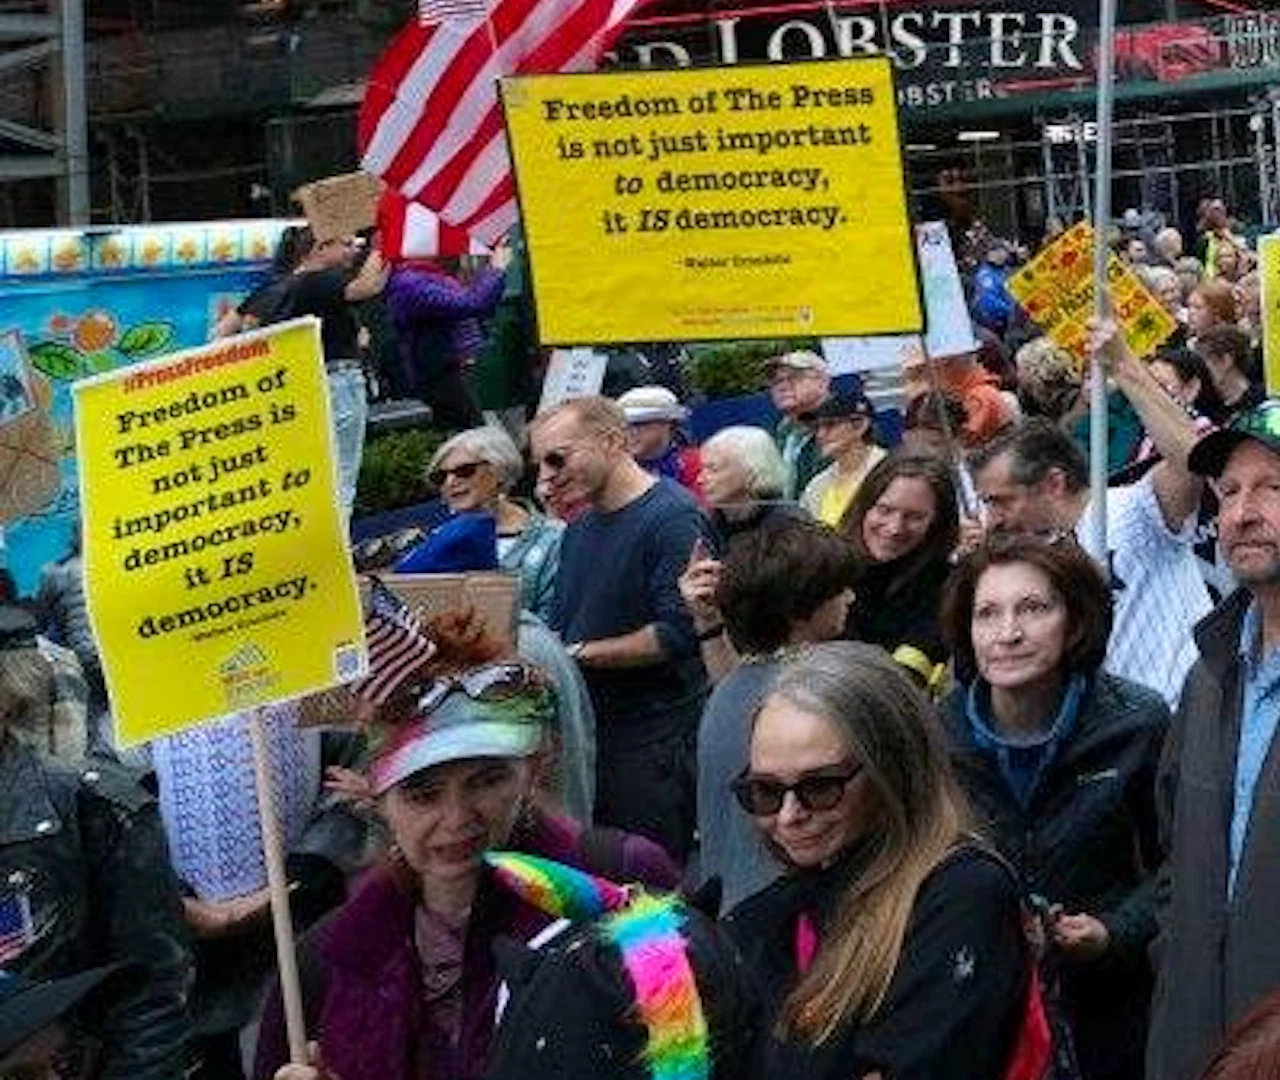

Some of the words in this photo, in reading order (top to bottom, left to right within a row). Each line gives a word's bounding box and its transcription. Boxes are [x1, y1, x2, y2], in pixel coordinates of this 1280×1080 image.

[542, 91, 680, 123] Freedom
[688, 89, 717, 114] of
[724, 86, 782, 111] The
[790, 82, 875, 109] Press
[557, 135, 585, 160] is
[593, 135, 643, 159] not
[647, 128, 709, 162] just
[716, 122, 873, 161] important
[614, 173, 643, 195] to
[656, 165, 831, 195] democracy,
[602, 209, 628, 234] it
[636, 207, 669, 232] IS
[674, 203, 848, 232] democracy.
[116, 384, 250, 434] Freedom
[256, 368, 288, 394] of
[114, 440, 171, 469] The
[179, 413, 263, 451] Press
[269, 403, 297, 425] is
[152, 468, 202, 495] not
[207, 443, 269, 484] just
[113, 477, 272, 540] important
[281, 467, 311, 492] to
[123, 507, 302, 572] democracy,
[183, 566, 211, 591] it
[220, 551, 254, 580] IS
[137, 573, 317, 639] democracy.
